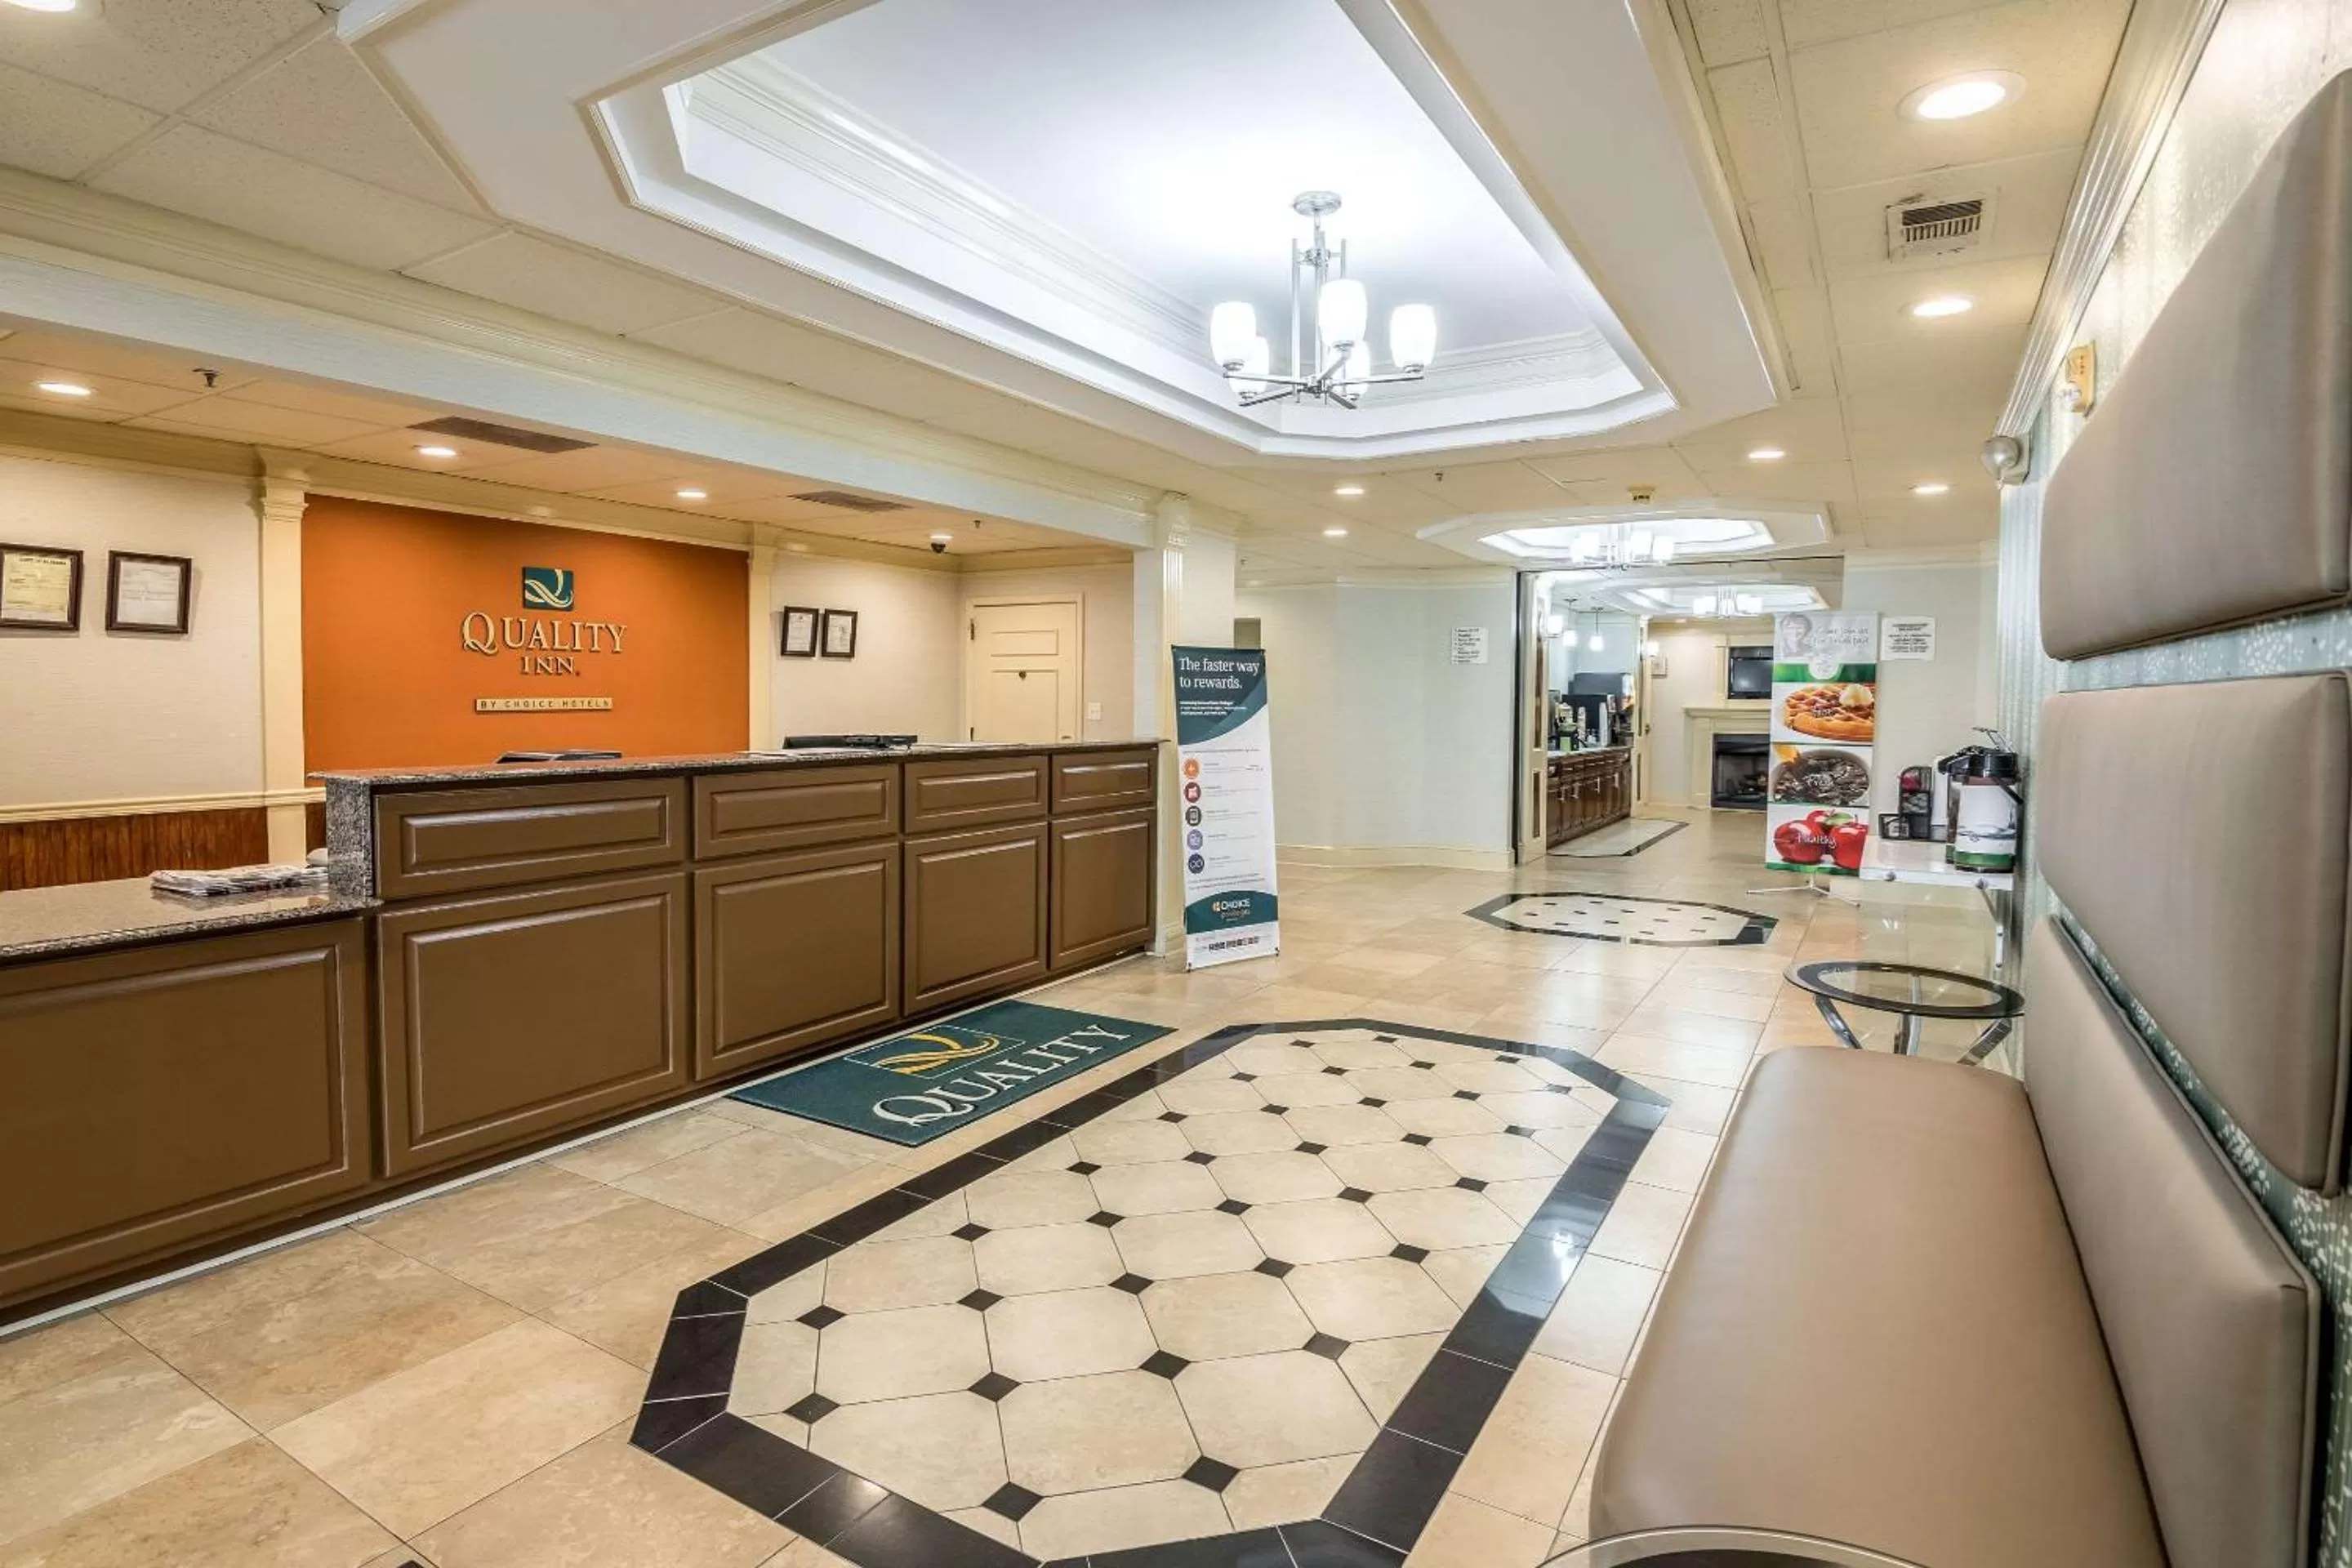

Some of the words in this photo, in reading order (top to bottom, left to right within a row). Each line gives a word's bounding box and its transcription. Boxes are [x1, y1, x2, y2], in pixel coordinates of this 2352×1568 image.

[461, 612, 628, 655] QUALITY
[520, 656, 575, 675] INN
[1179, 657, 1200, 670] The
[1202, 658, 1235, 672] faster
[1236, 662, 1259, 676] way
[1179, 676, 1191, 688] to
[1193, 675, 1243, 689] rewards.
[480, 701, 497, 709] BY
[504, 700, 554, 708] CHOICE
[562, 699, 610, 707] HOTELS
[871, 1023, 1134, 1128] QUALITY
